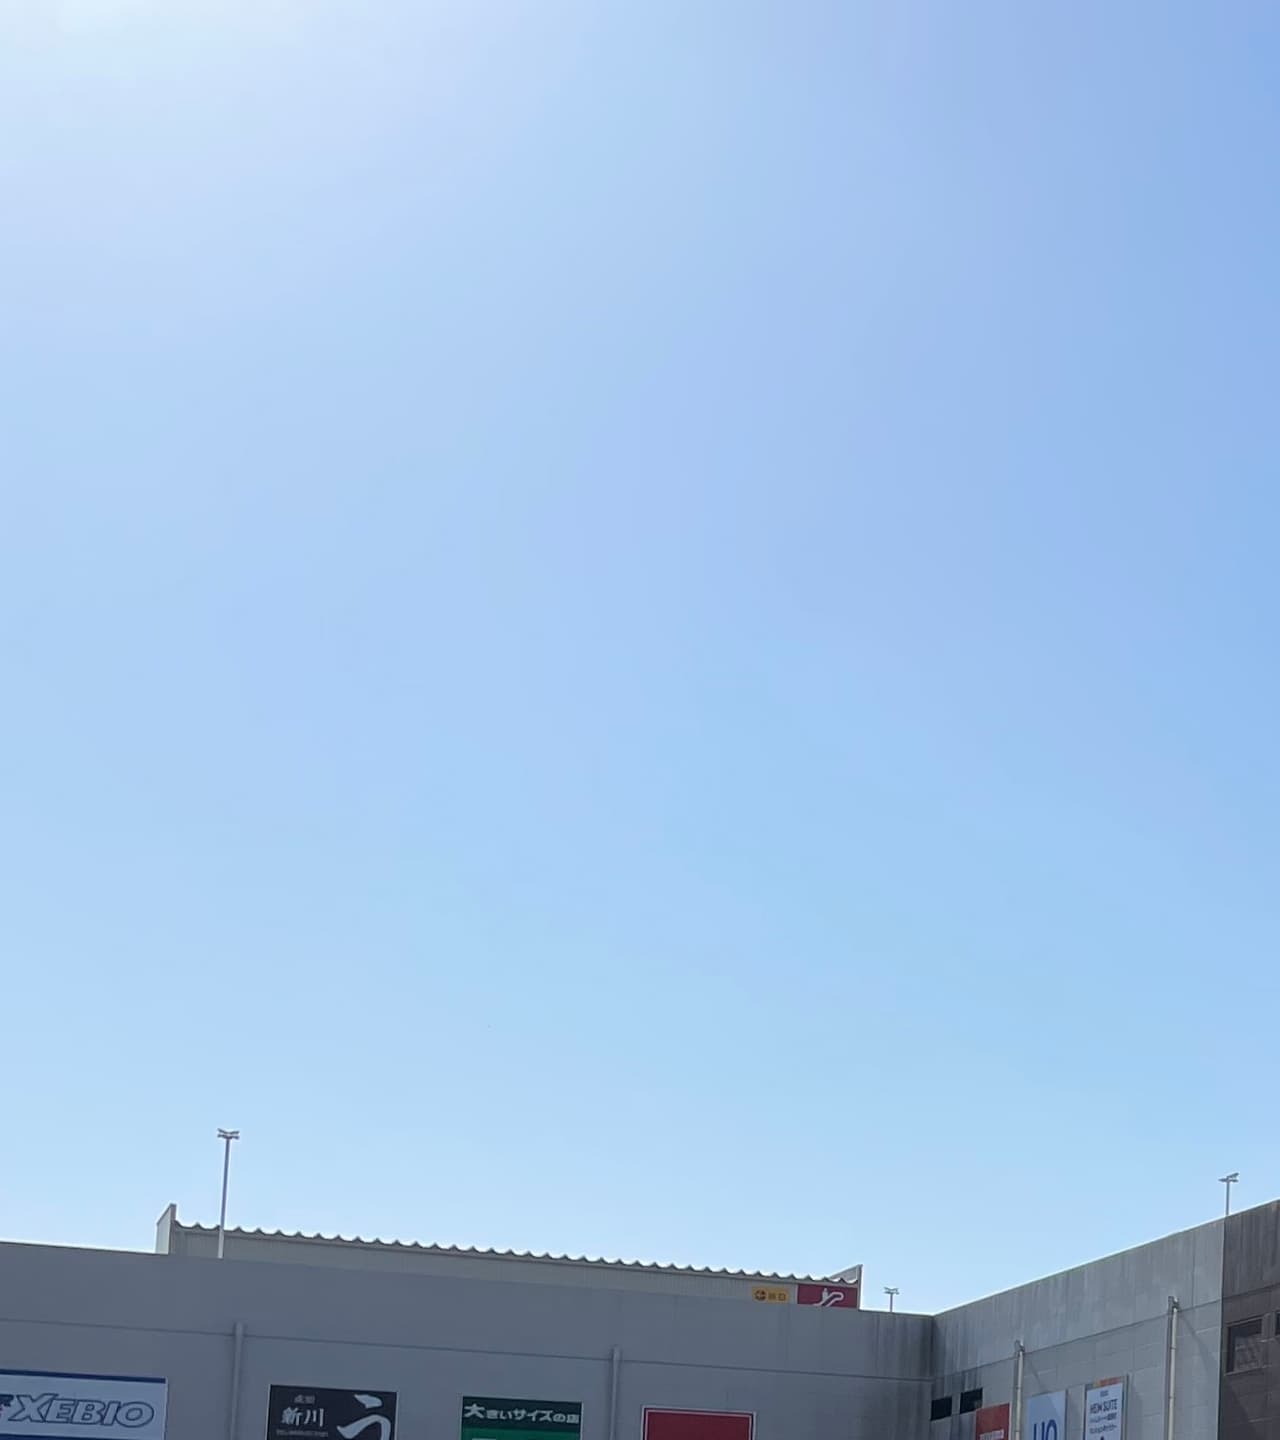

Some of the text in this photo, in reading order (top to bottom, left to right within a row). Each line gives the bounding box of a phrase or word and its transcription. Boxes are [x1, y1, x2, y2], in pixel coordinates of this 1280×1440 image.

[8, 1392, 155, 1429] XEBIO
[281, 1407, 325, 1427] 新川
[463, 1403, 580, 1424] 大きいサイズの店
